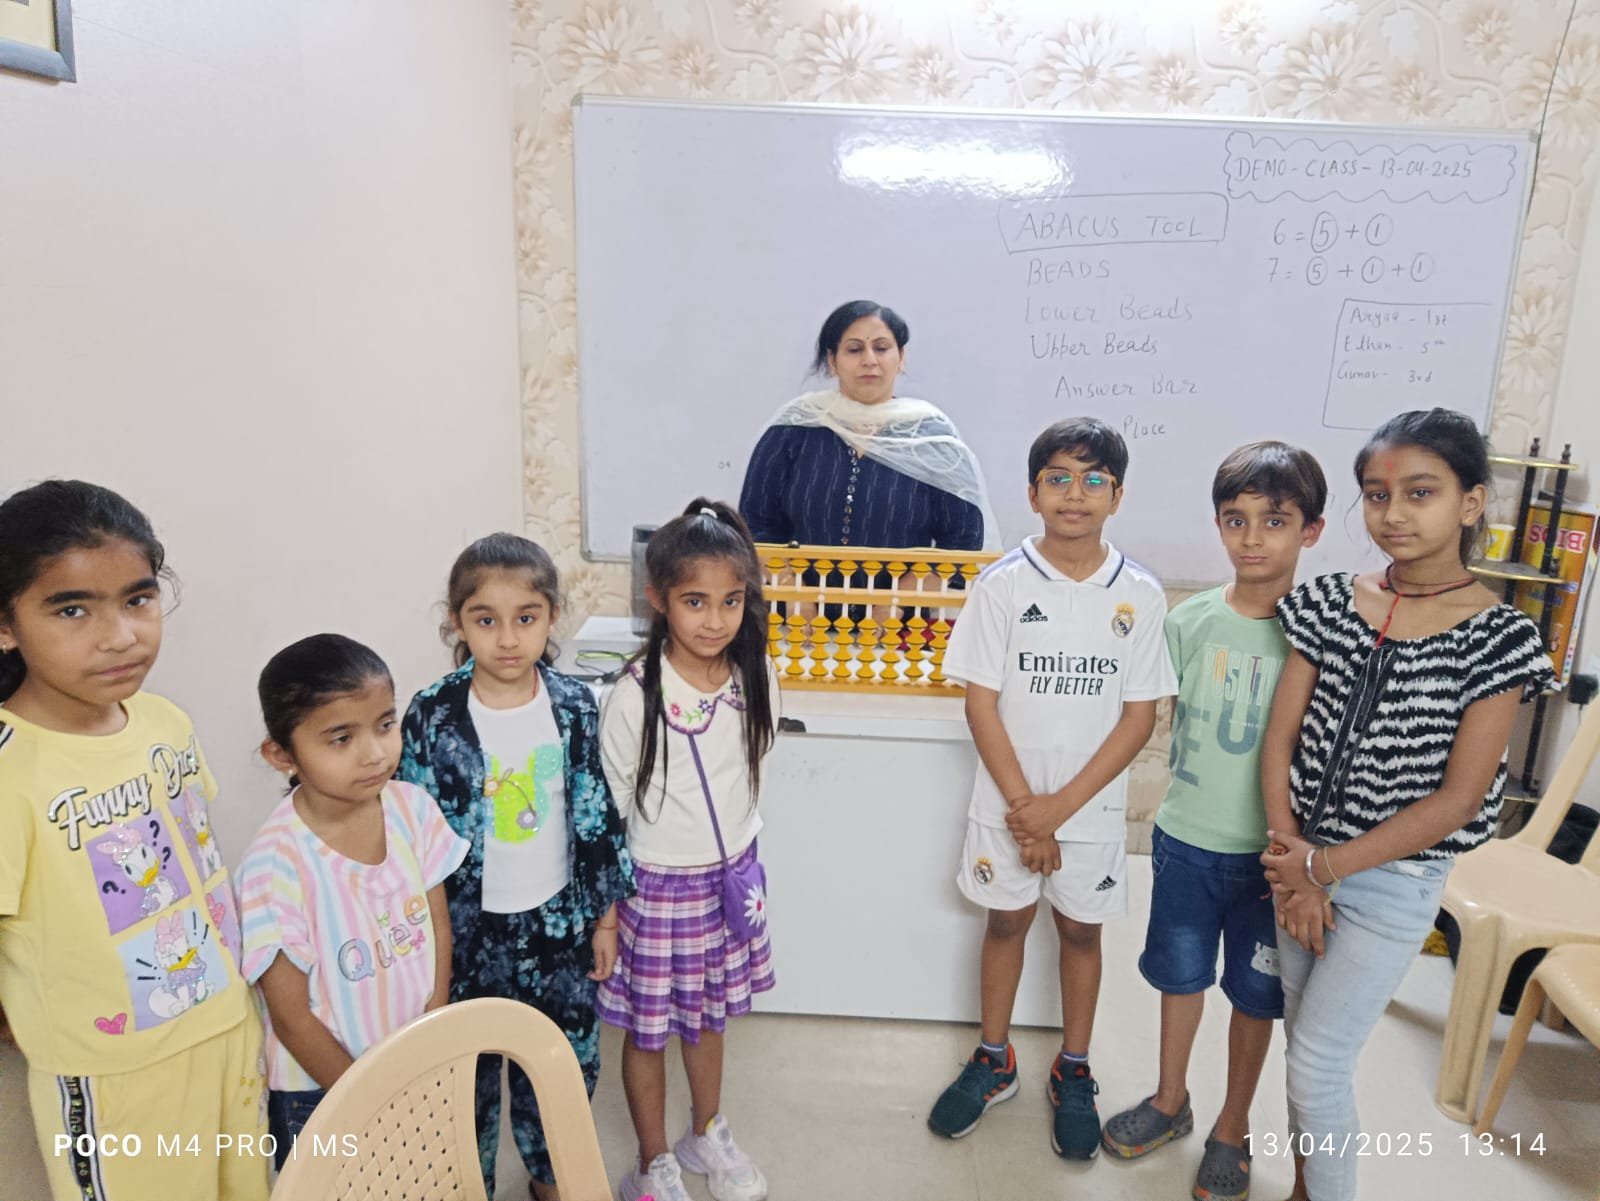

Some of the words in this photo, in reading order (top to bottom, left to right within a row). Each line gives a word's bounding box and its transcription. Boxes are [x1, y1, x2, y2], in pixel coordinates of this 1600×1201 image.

[1237, 157, 1287, 182] DEMO
[1304, 159, 1358, 178] CLASS
[1015, 212, 1120, 241] ABACUS
[1273, 217, 1287, 246] 6
[1026, 257, 1111, 288] BEADS
[1268, 257, 1279, 282] 7
[1024, 296, 1101, 324] Lower
[1119, 291, 1193, 321] Beads
[1030, 332, 1092, 360] Upper
[1103, 332, 1158, 356] Beads
[1054, 375, 1136, 400] Answer
[1122, 414, 1167, 439] Place
[1019, 614, 1049, 624] adidas
[1018, 651, 1119, 675] Emirates
[1029, 675, 1052, 694] FLY
[1054, 676, 1104, 696] BETTER
[48, 772, 153, 852] Funny
